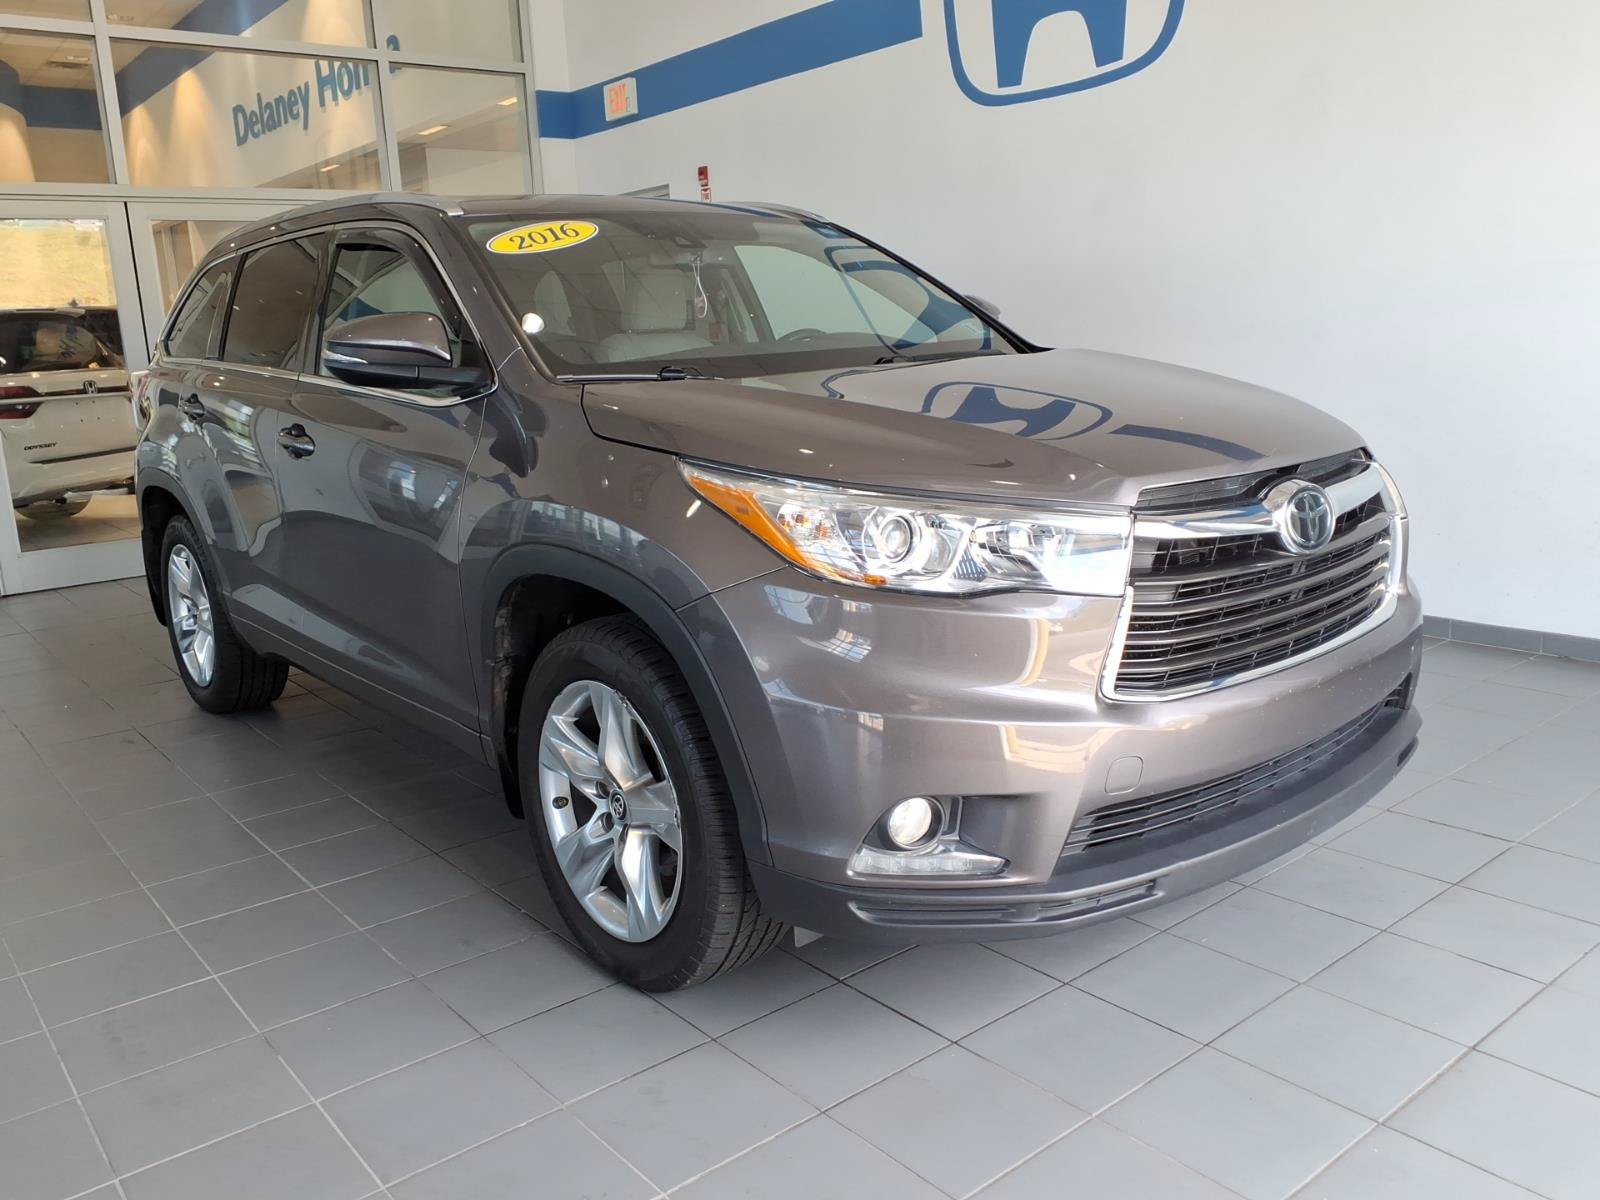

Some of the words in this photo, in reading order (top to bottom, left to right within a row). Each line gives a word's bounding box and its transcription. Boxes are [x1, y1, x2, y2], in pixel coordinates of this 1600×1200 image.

[232, 81, 310, 147] Delaney
[314, 34, 401, 108] Hona
[607, 82, 627, 113] EXIT
[509, 223, 580, 250] 2016
